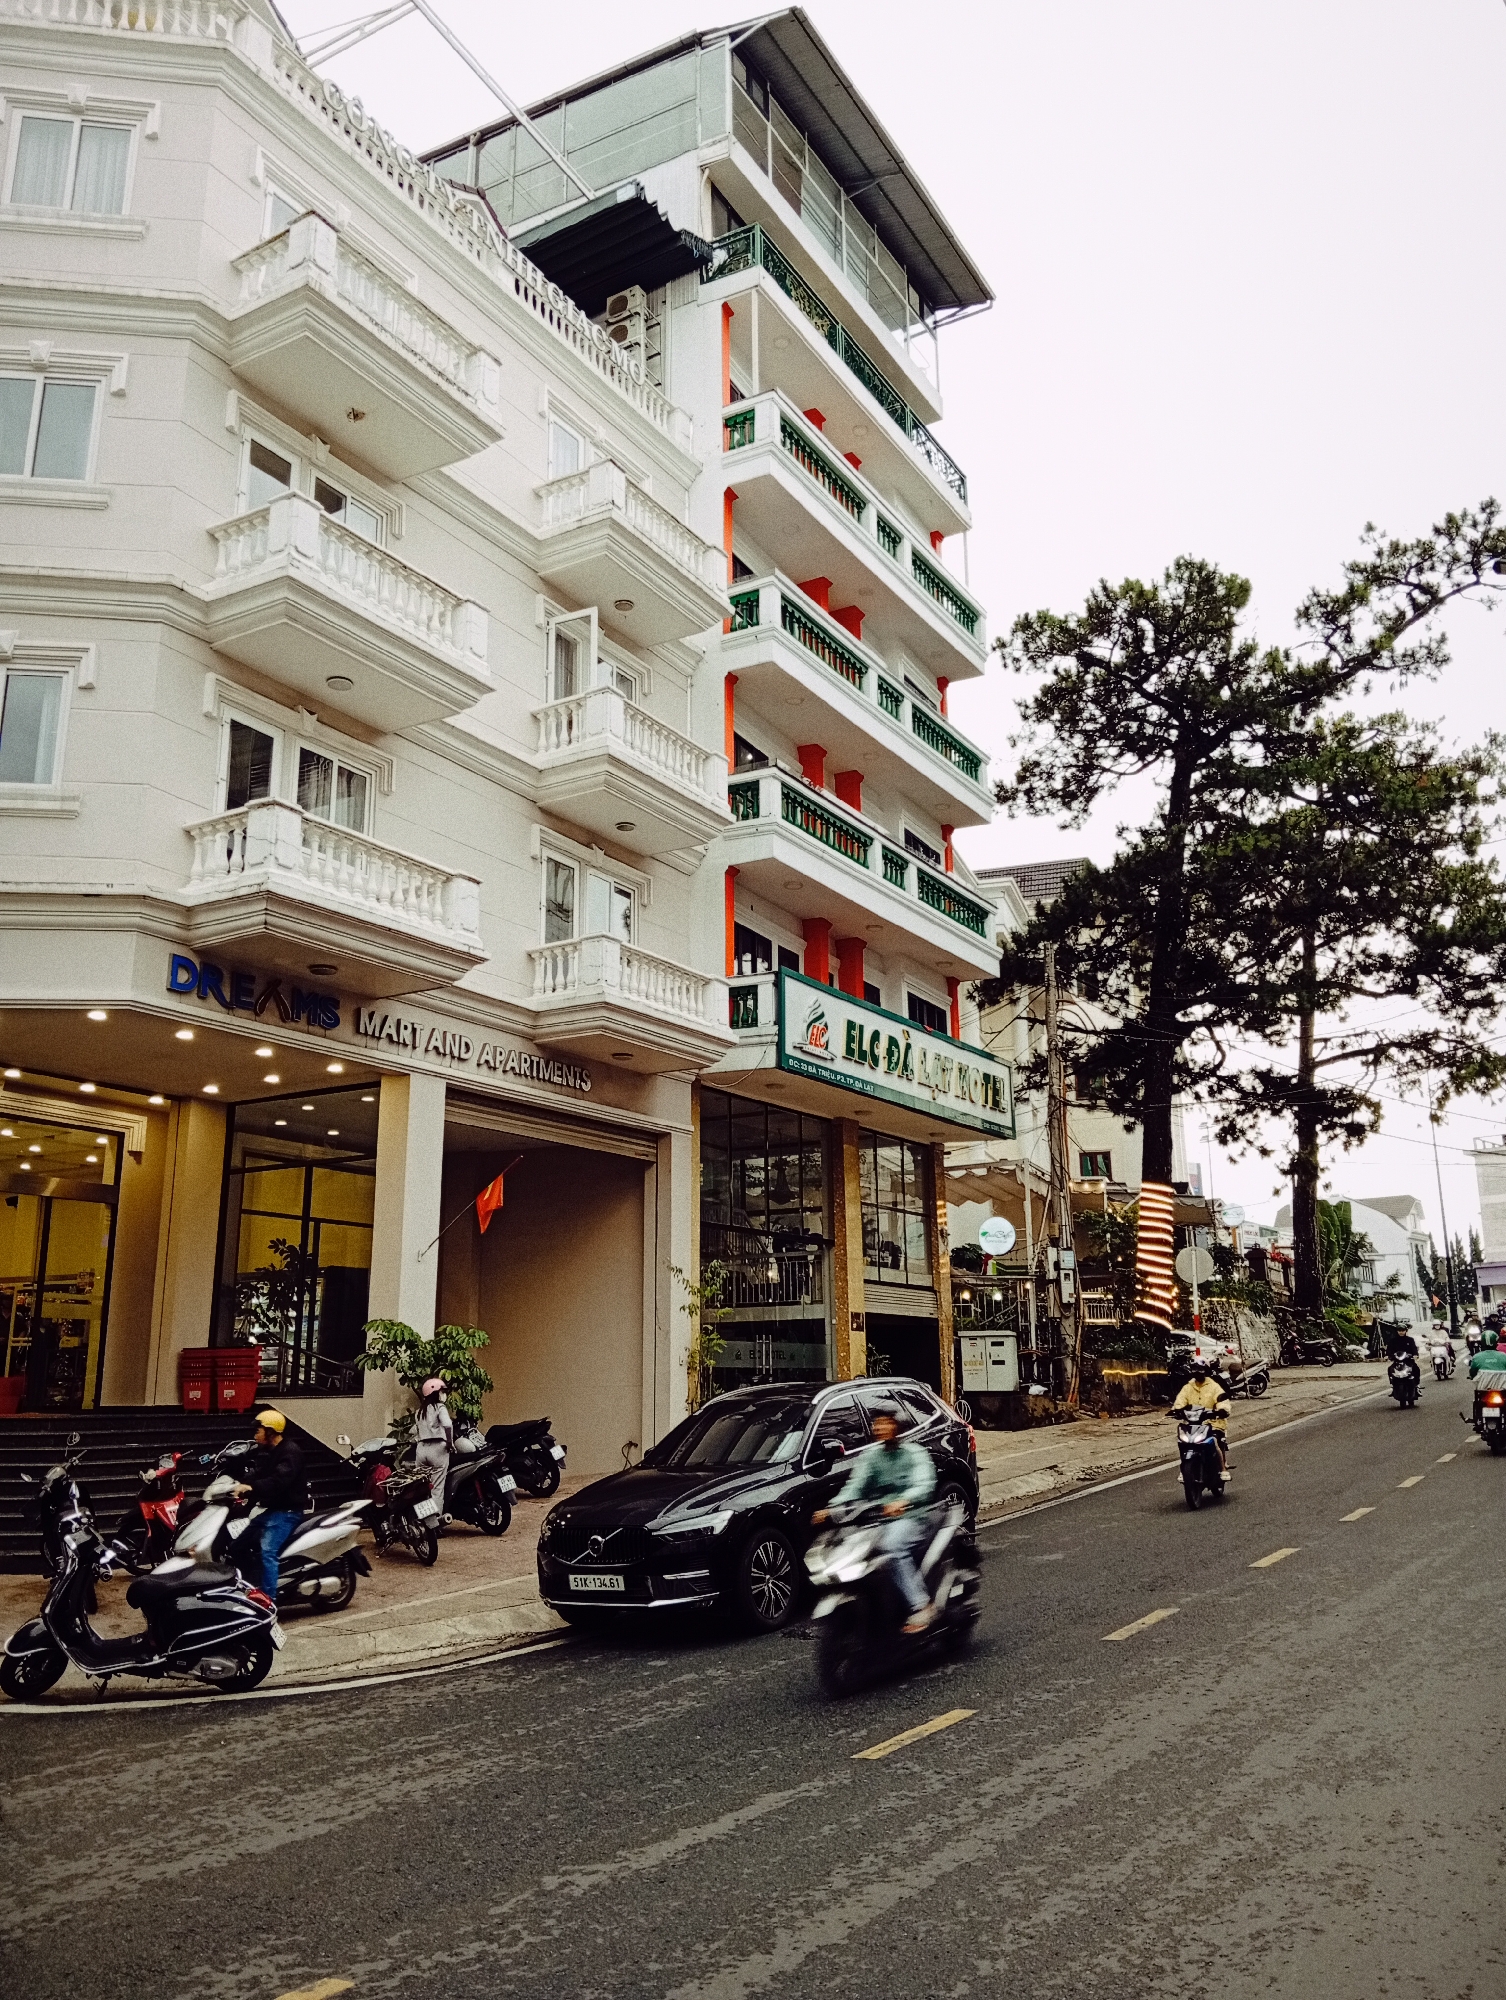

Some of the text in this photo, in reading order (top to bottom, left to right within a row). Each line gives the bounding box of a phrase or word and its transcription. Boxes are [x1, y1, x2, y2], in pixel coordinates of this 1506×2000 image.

[323, 79, 415, 179] CÔNG
[167, 953, 592, 1092] DREAMS MART AND APARTMENTS
[809, 1024, 828, 1049] ELC
[843, 1018, 880, 1070] ELC
[573, 1577, 620, 1589] 51K-134.61
